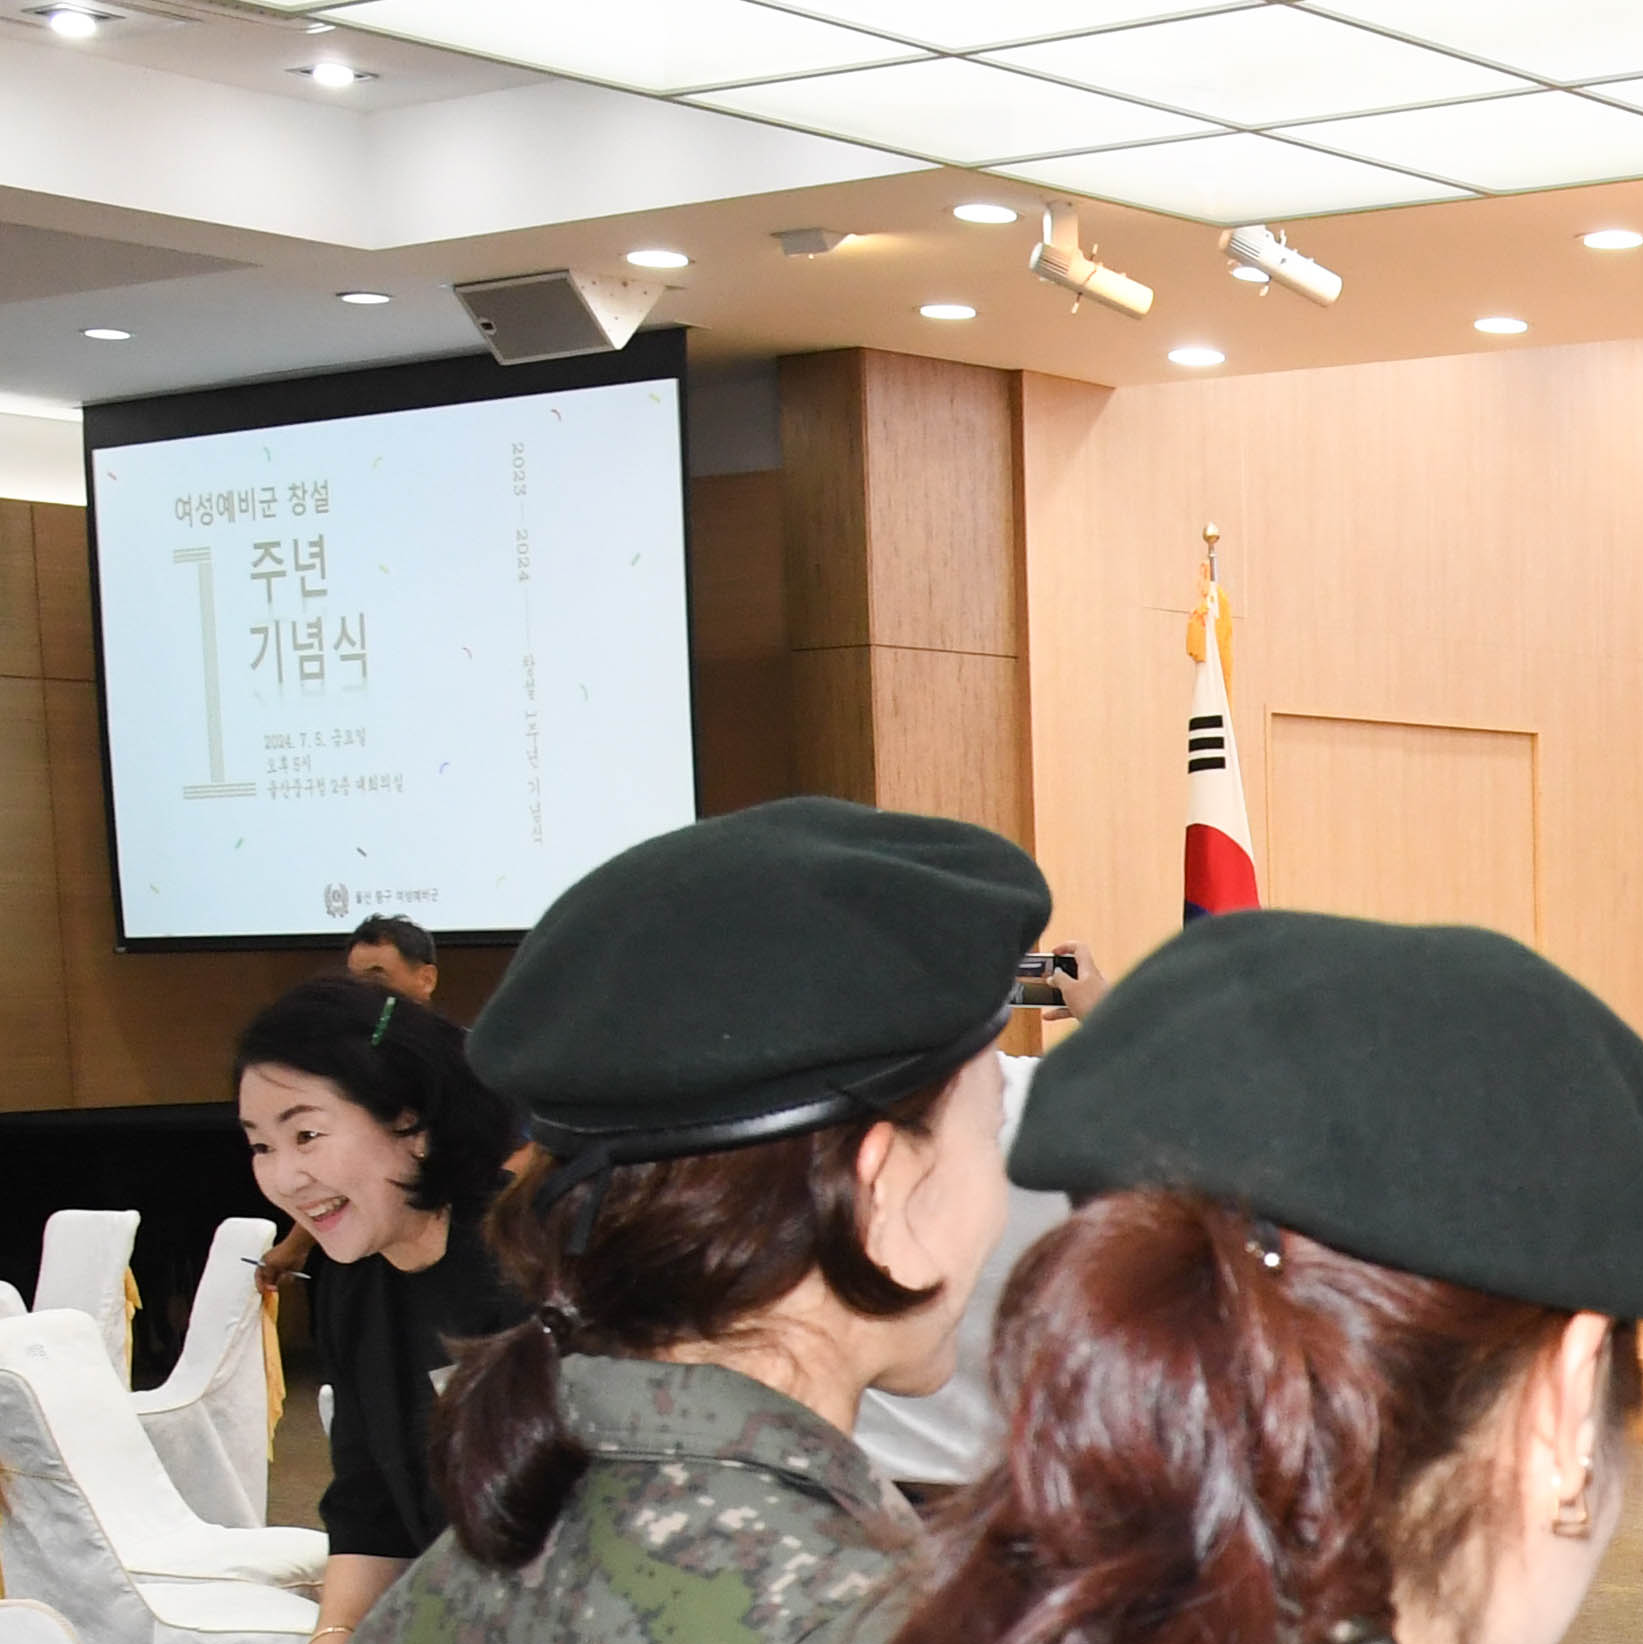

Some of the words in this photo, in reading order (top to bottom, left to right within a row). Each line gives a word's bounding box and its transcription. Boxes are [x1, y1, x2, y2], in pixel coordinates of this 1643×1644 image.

[174, 486, 278, 528] 여성예비군
[288, 479, 330, 517] 창설
[250, 533, 328, 604] 주년
[250, 612, 368, 685] 기념식
